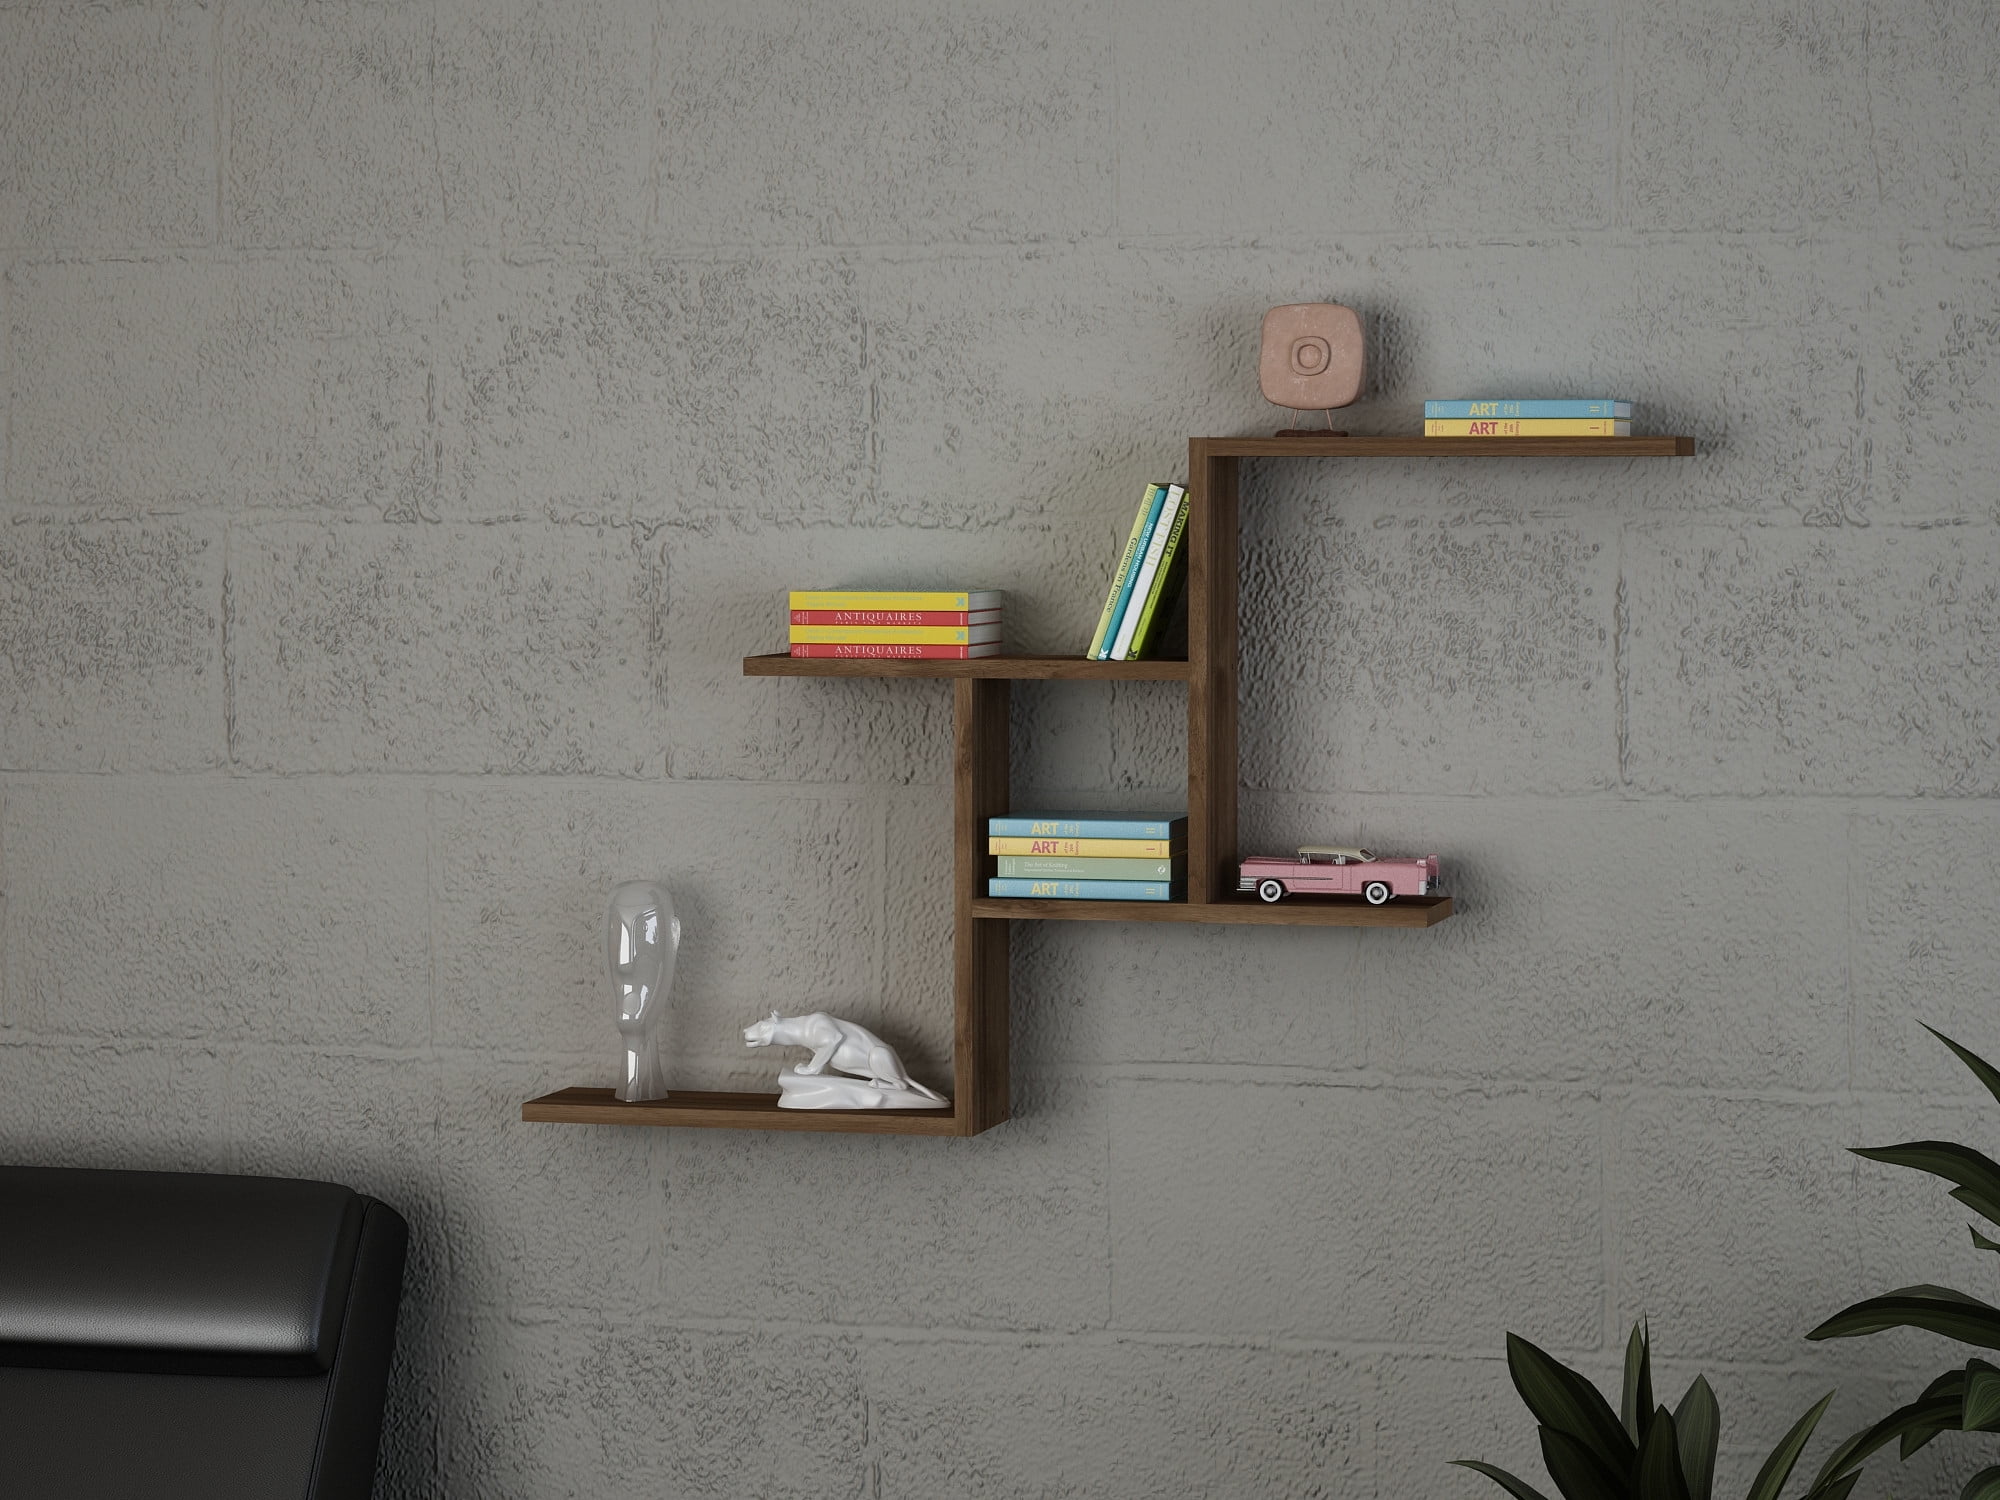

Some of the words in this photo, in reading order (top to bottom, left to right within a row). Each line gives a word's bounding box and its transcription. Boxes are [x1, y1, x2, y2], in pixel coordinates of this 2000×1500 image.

[1469, 403, 1498, 416] ART
[1469, 422, 1498, 435] ART
[1159, 490, 1180, 530] LOST
[1144, 523, 1153, 537] NEW
[1173, 502, 1189, 544] MAKING
[1120, 538, 1138, 572] Gardens
[1137, 537, 1148, 559] URBAN
[1146, 532, 1166, 566] FISH
[1165, 545, 1174, 557] IT
[1117, 573, 1124, 582] in
[1127, 559, 1140, 588] HOUSING
[1106, 583, 1121, 612] France
[835, 612, 922, 622] ANTIQUAIRES
[835, 646, 922, 655] ANTIQUAIRES
[1031, 822, 1059, 835] ART
[1031, 841, 1059, 854] ART
[1031, 882, 1059, 896] ART
